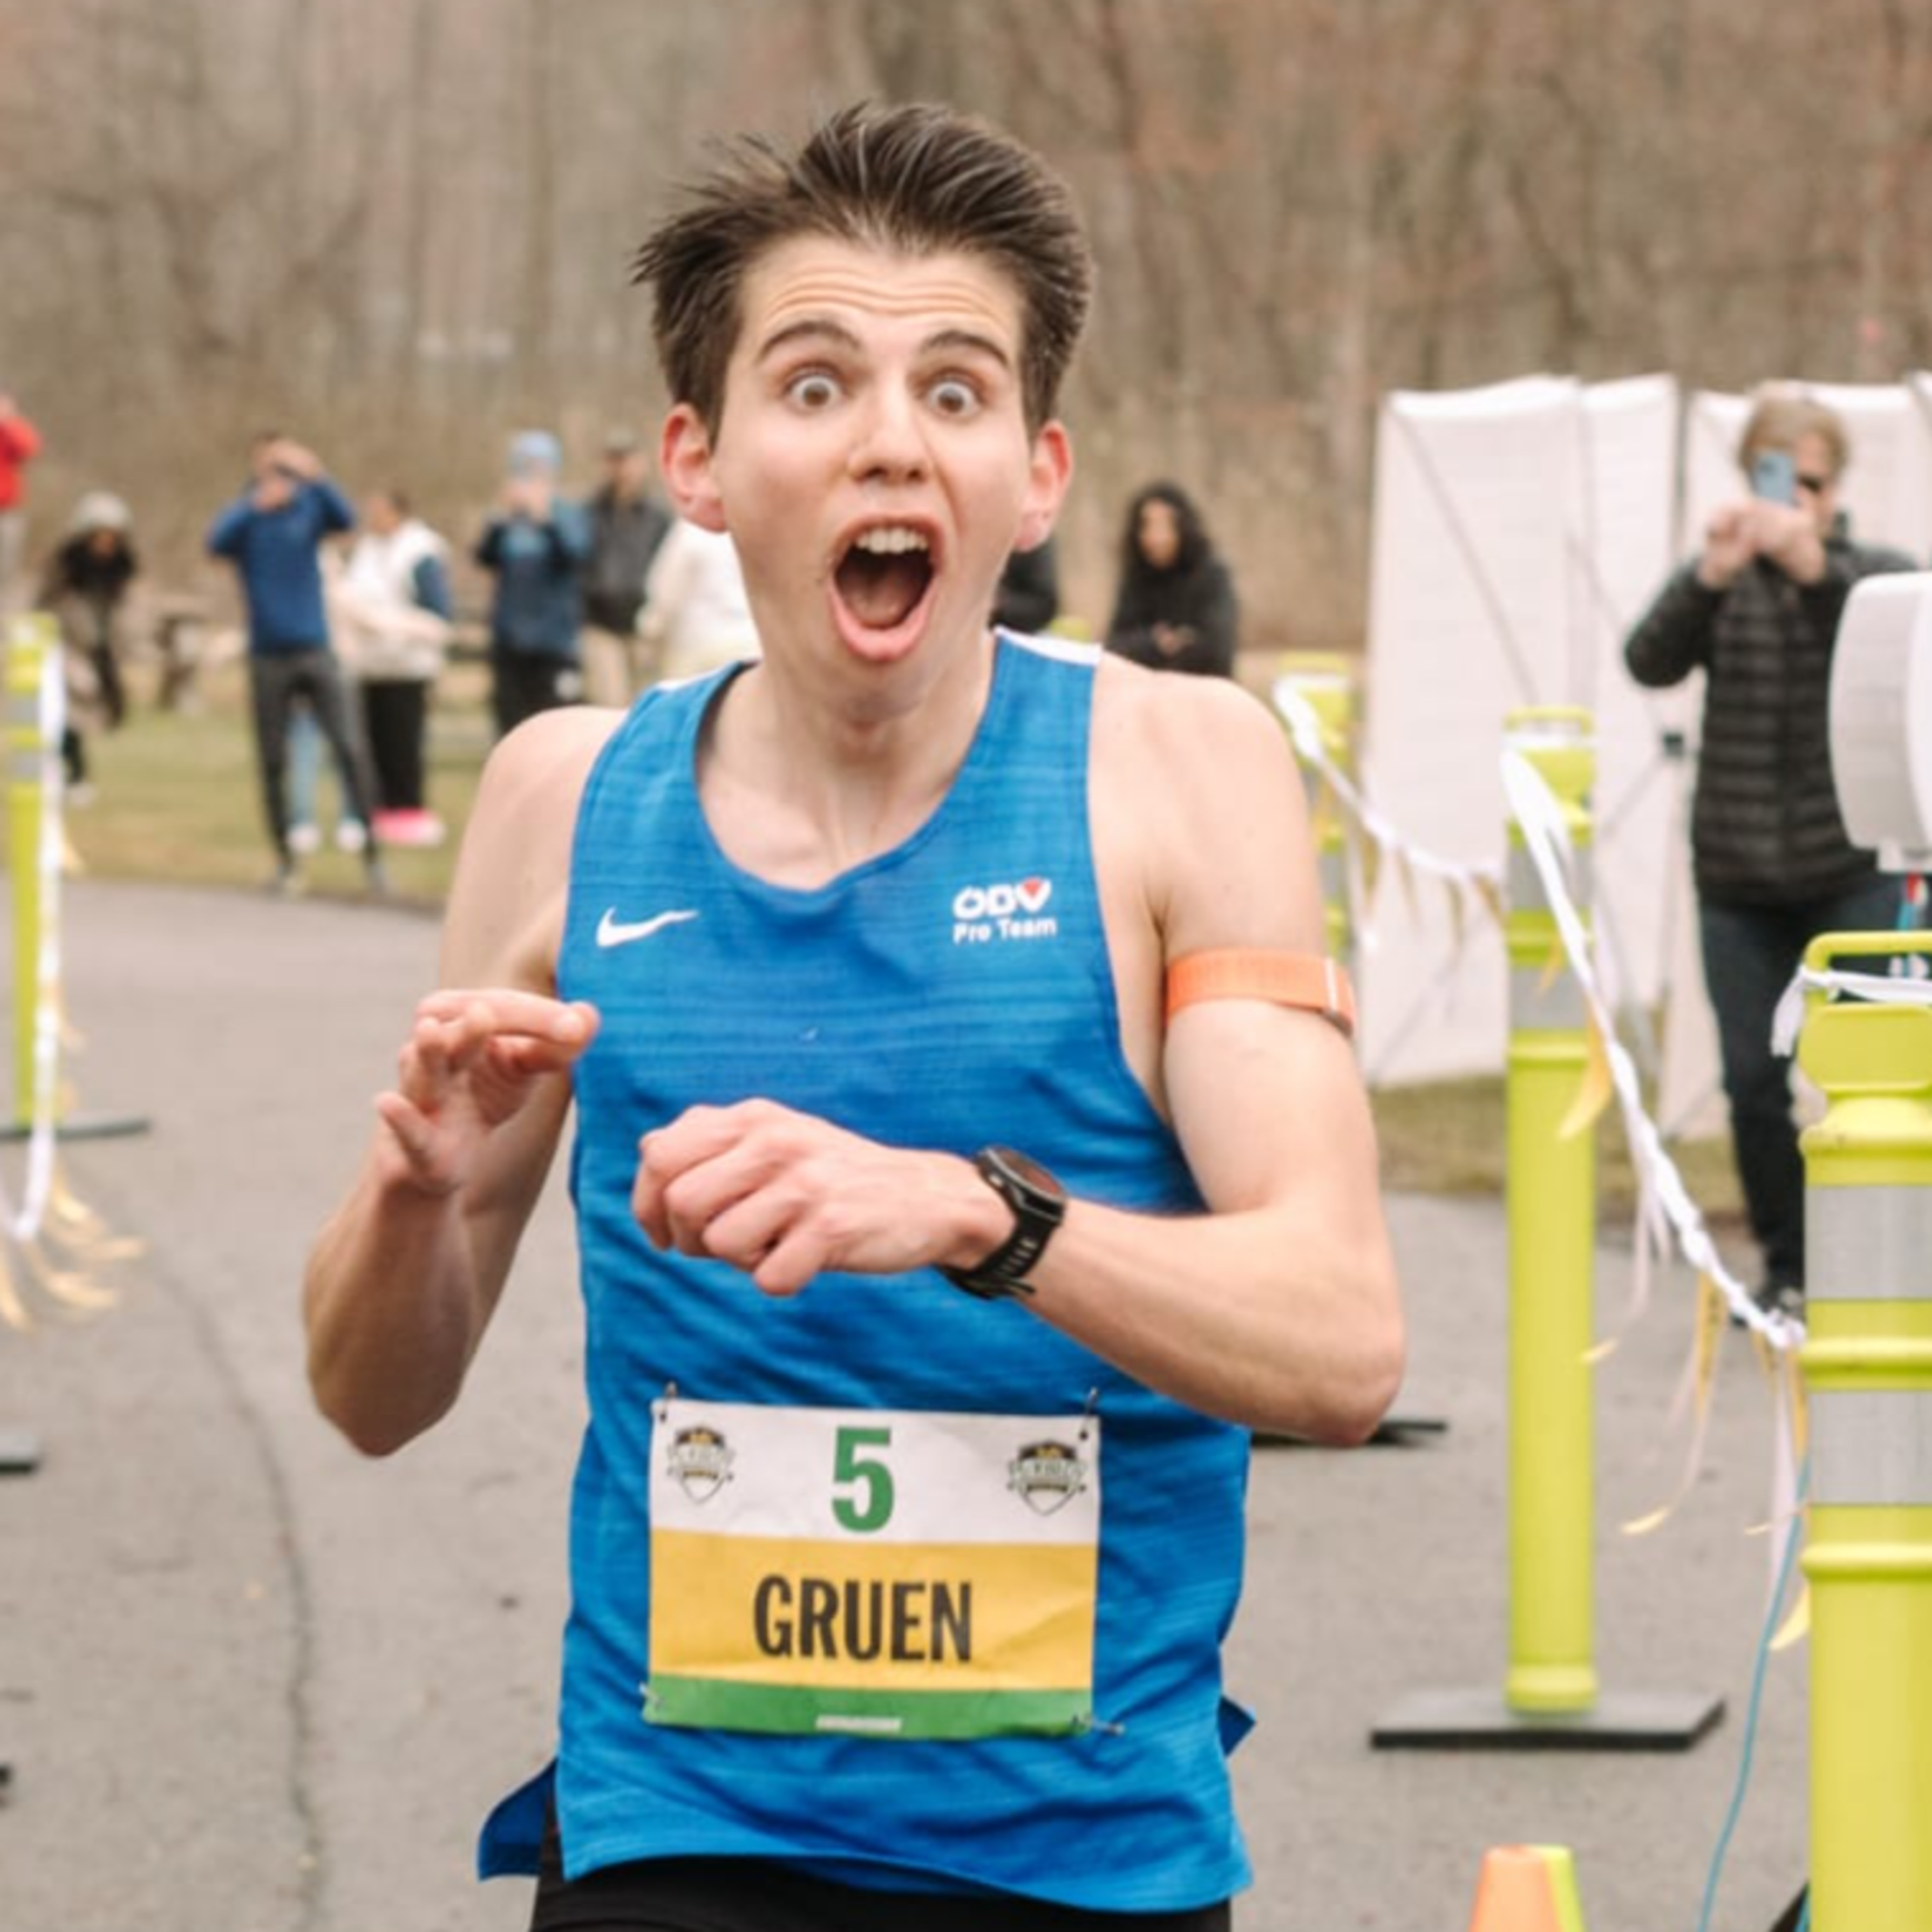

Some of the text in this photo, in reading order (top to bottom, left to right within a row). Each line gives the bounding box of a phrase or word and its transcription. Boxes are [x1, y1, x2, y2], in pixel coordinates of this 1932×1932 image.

[953, 916, 1057, 944] Pro Team
[832, 1426, 895, 1532] 5
[753, 1575, 972, 1662] GRUEN
